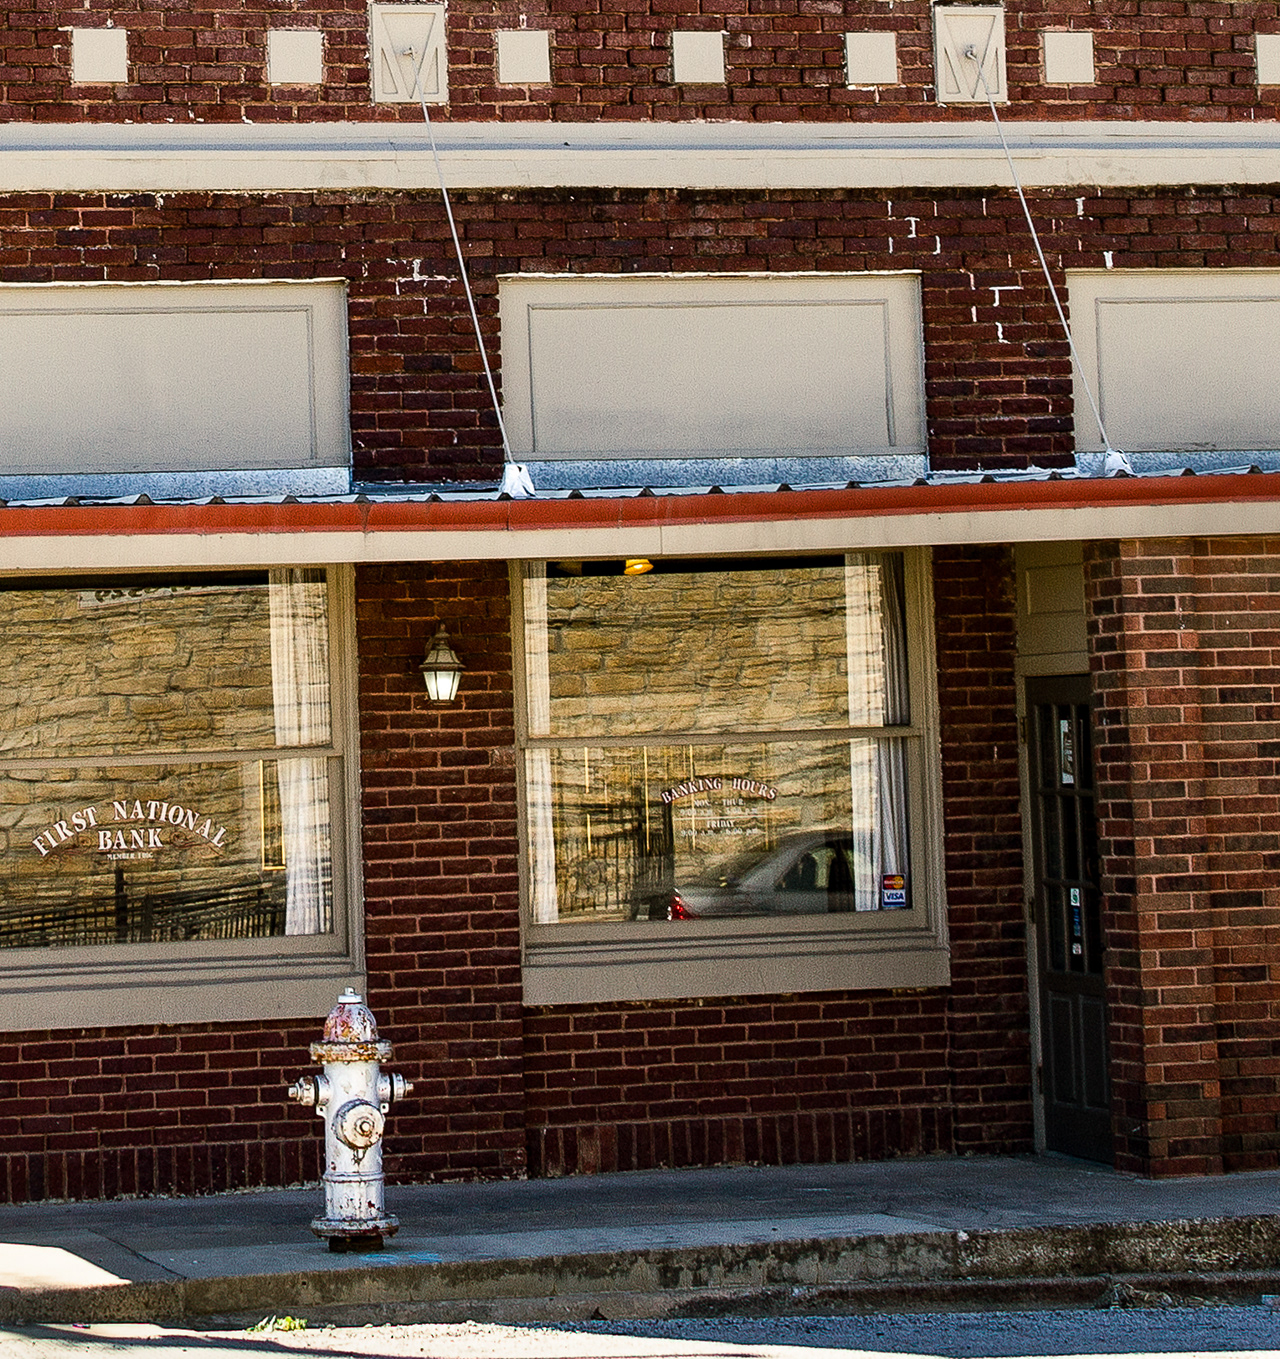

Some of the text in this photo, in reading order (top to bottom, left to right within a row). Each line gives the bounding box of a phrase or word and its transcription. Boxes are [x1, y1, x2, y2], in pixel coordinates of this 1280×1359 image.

[661, 777, 778, 804] BANKING HOURS
[32, 799, 227, 857] FIRST NATIONAL
[98, 828, 164, 850] BANK
[885, 892, 905, 901] VISA
